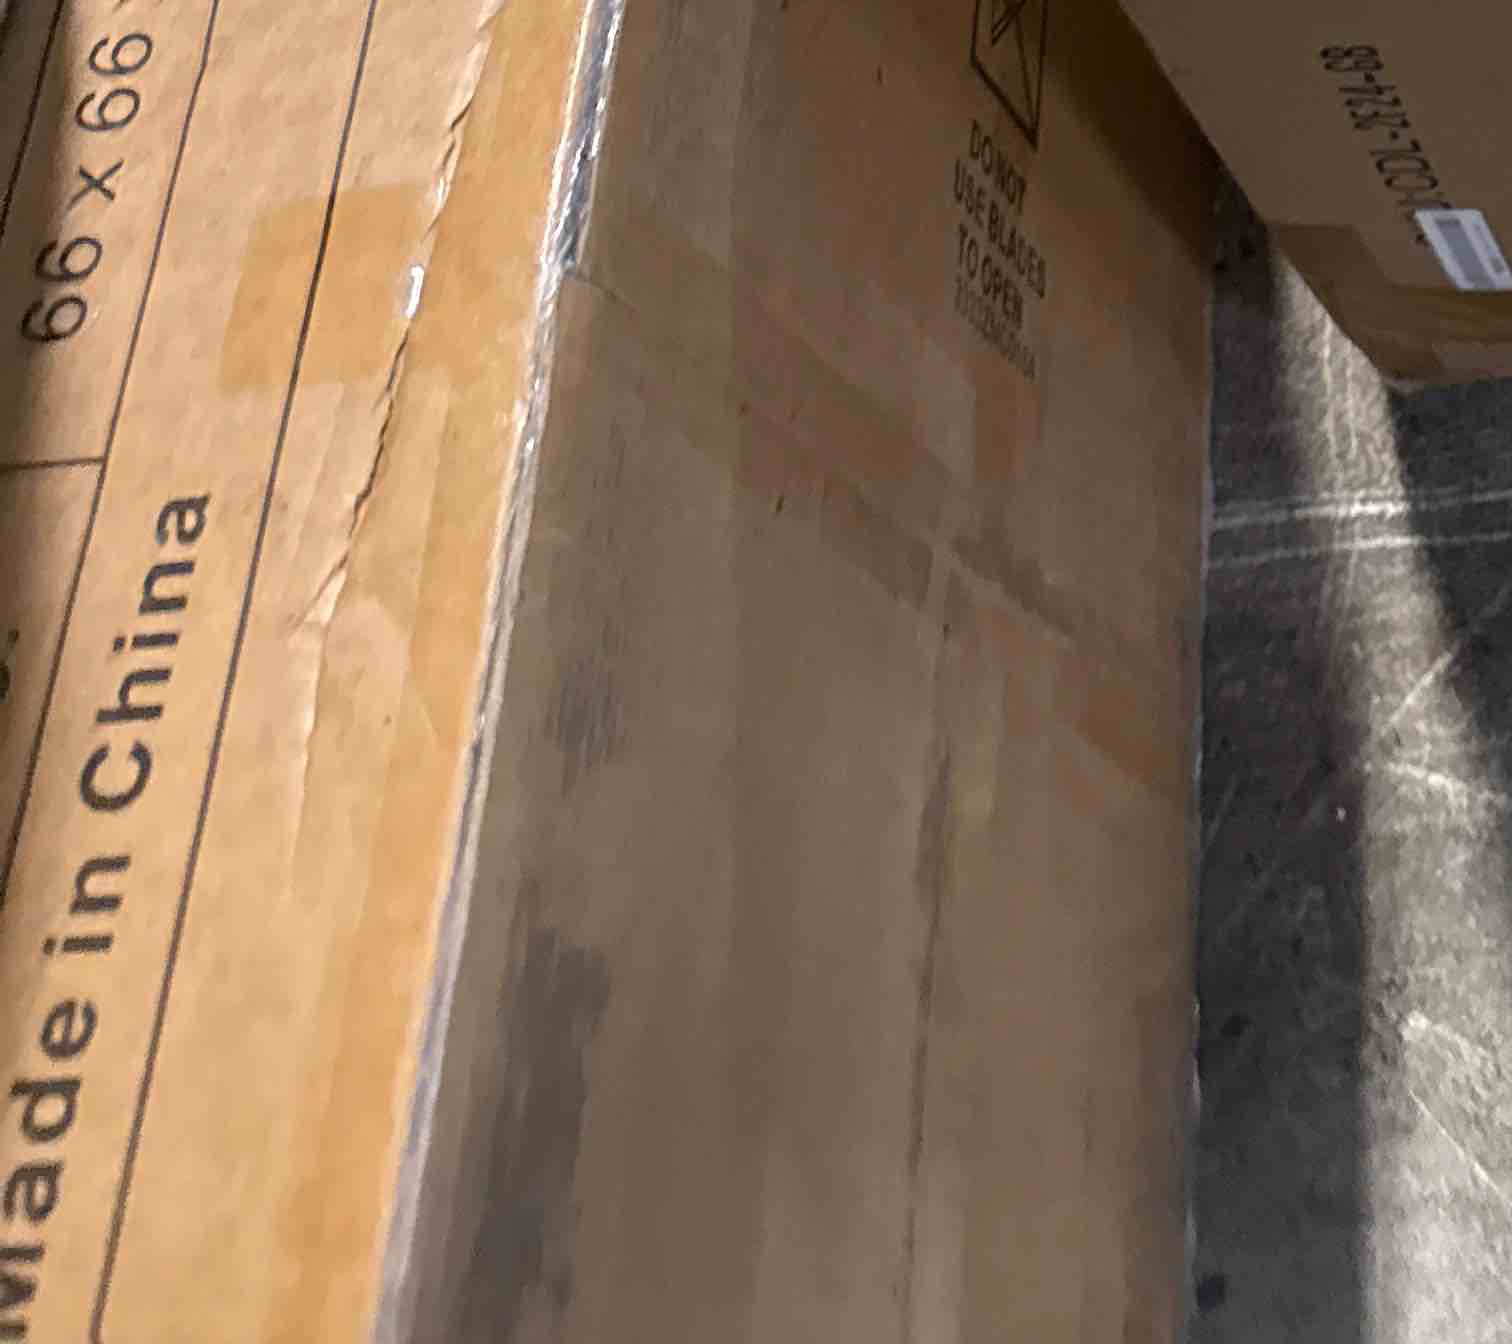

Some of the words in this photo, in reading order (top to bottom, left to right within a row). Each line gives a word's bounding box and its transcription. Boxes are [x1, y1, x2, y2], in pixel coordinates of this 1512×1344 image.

[74, 30, 154, 135] 66
[79, 158, 126, 204] x
[953, 158, 987, 230] USE
[21, 235, 105, 344] 66
[956, 223, 981, 278] TO
[80, 493, 212, 814] China
[42, 854, 130, 957] in
